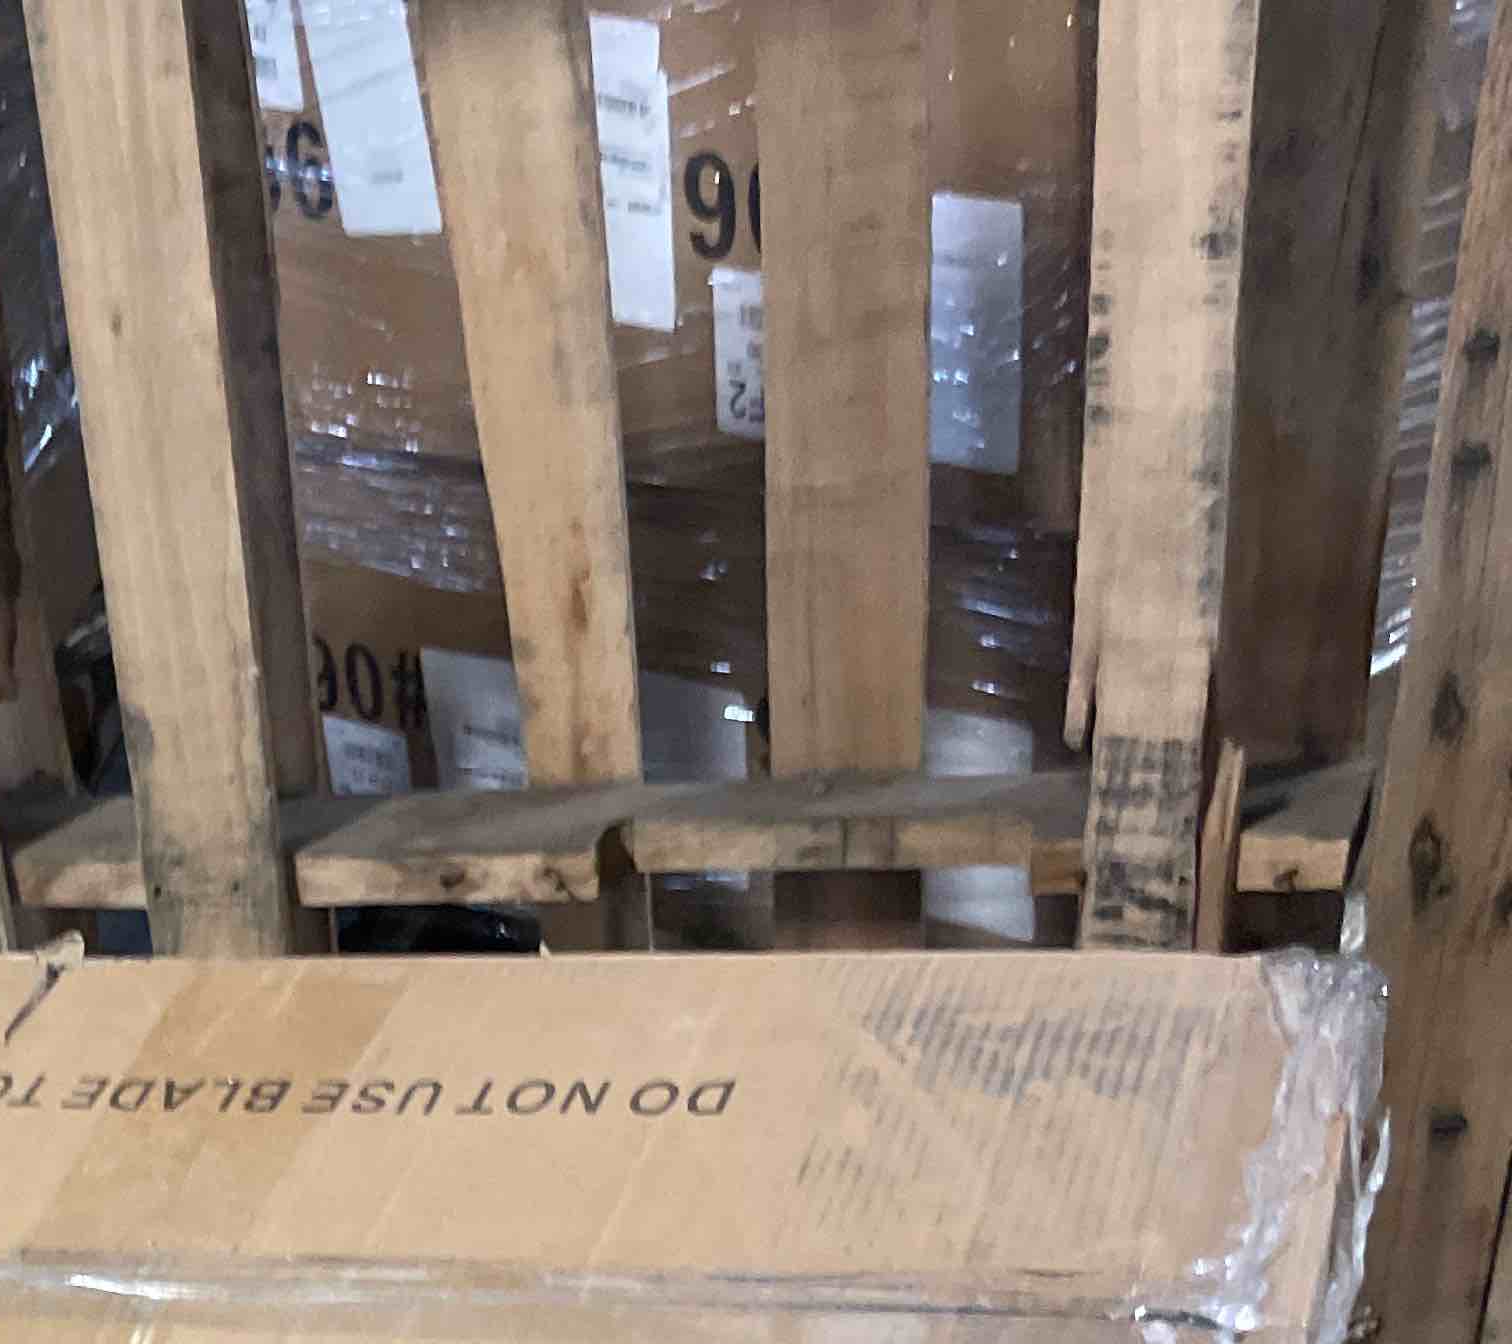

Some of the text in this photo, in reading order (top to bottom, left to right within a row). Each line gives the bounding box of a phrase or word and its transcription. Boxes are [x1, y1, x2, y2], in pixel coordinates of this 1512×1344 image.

[61, 1075, 292, 1114] BLADE
[301, 1077, 444, 1115] USE
[455, 1077, 612, 1116] NOT
[630, 1078, 737, 1116] DO
